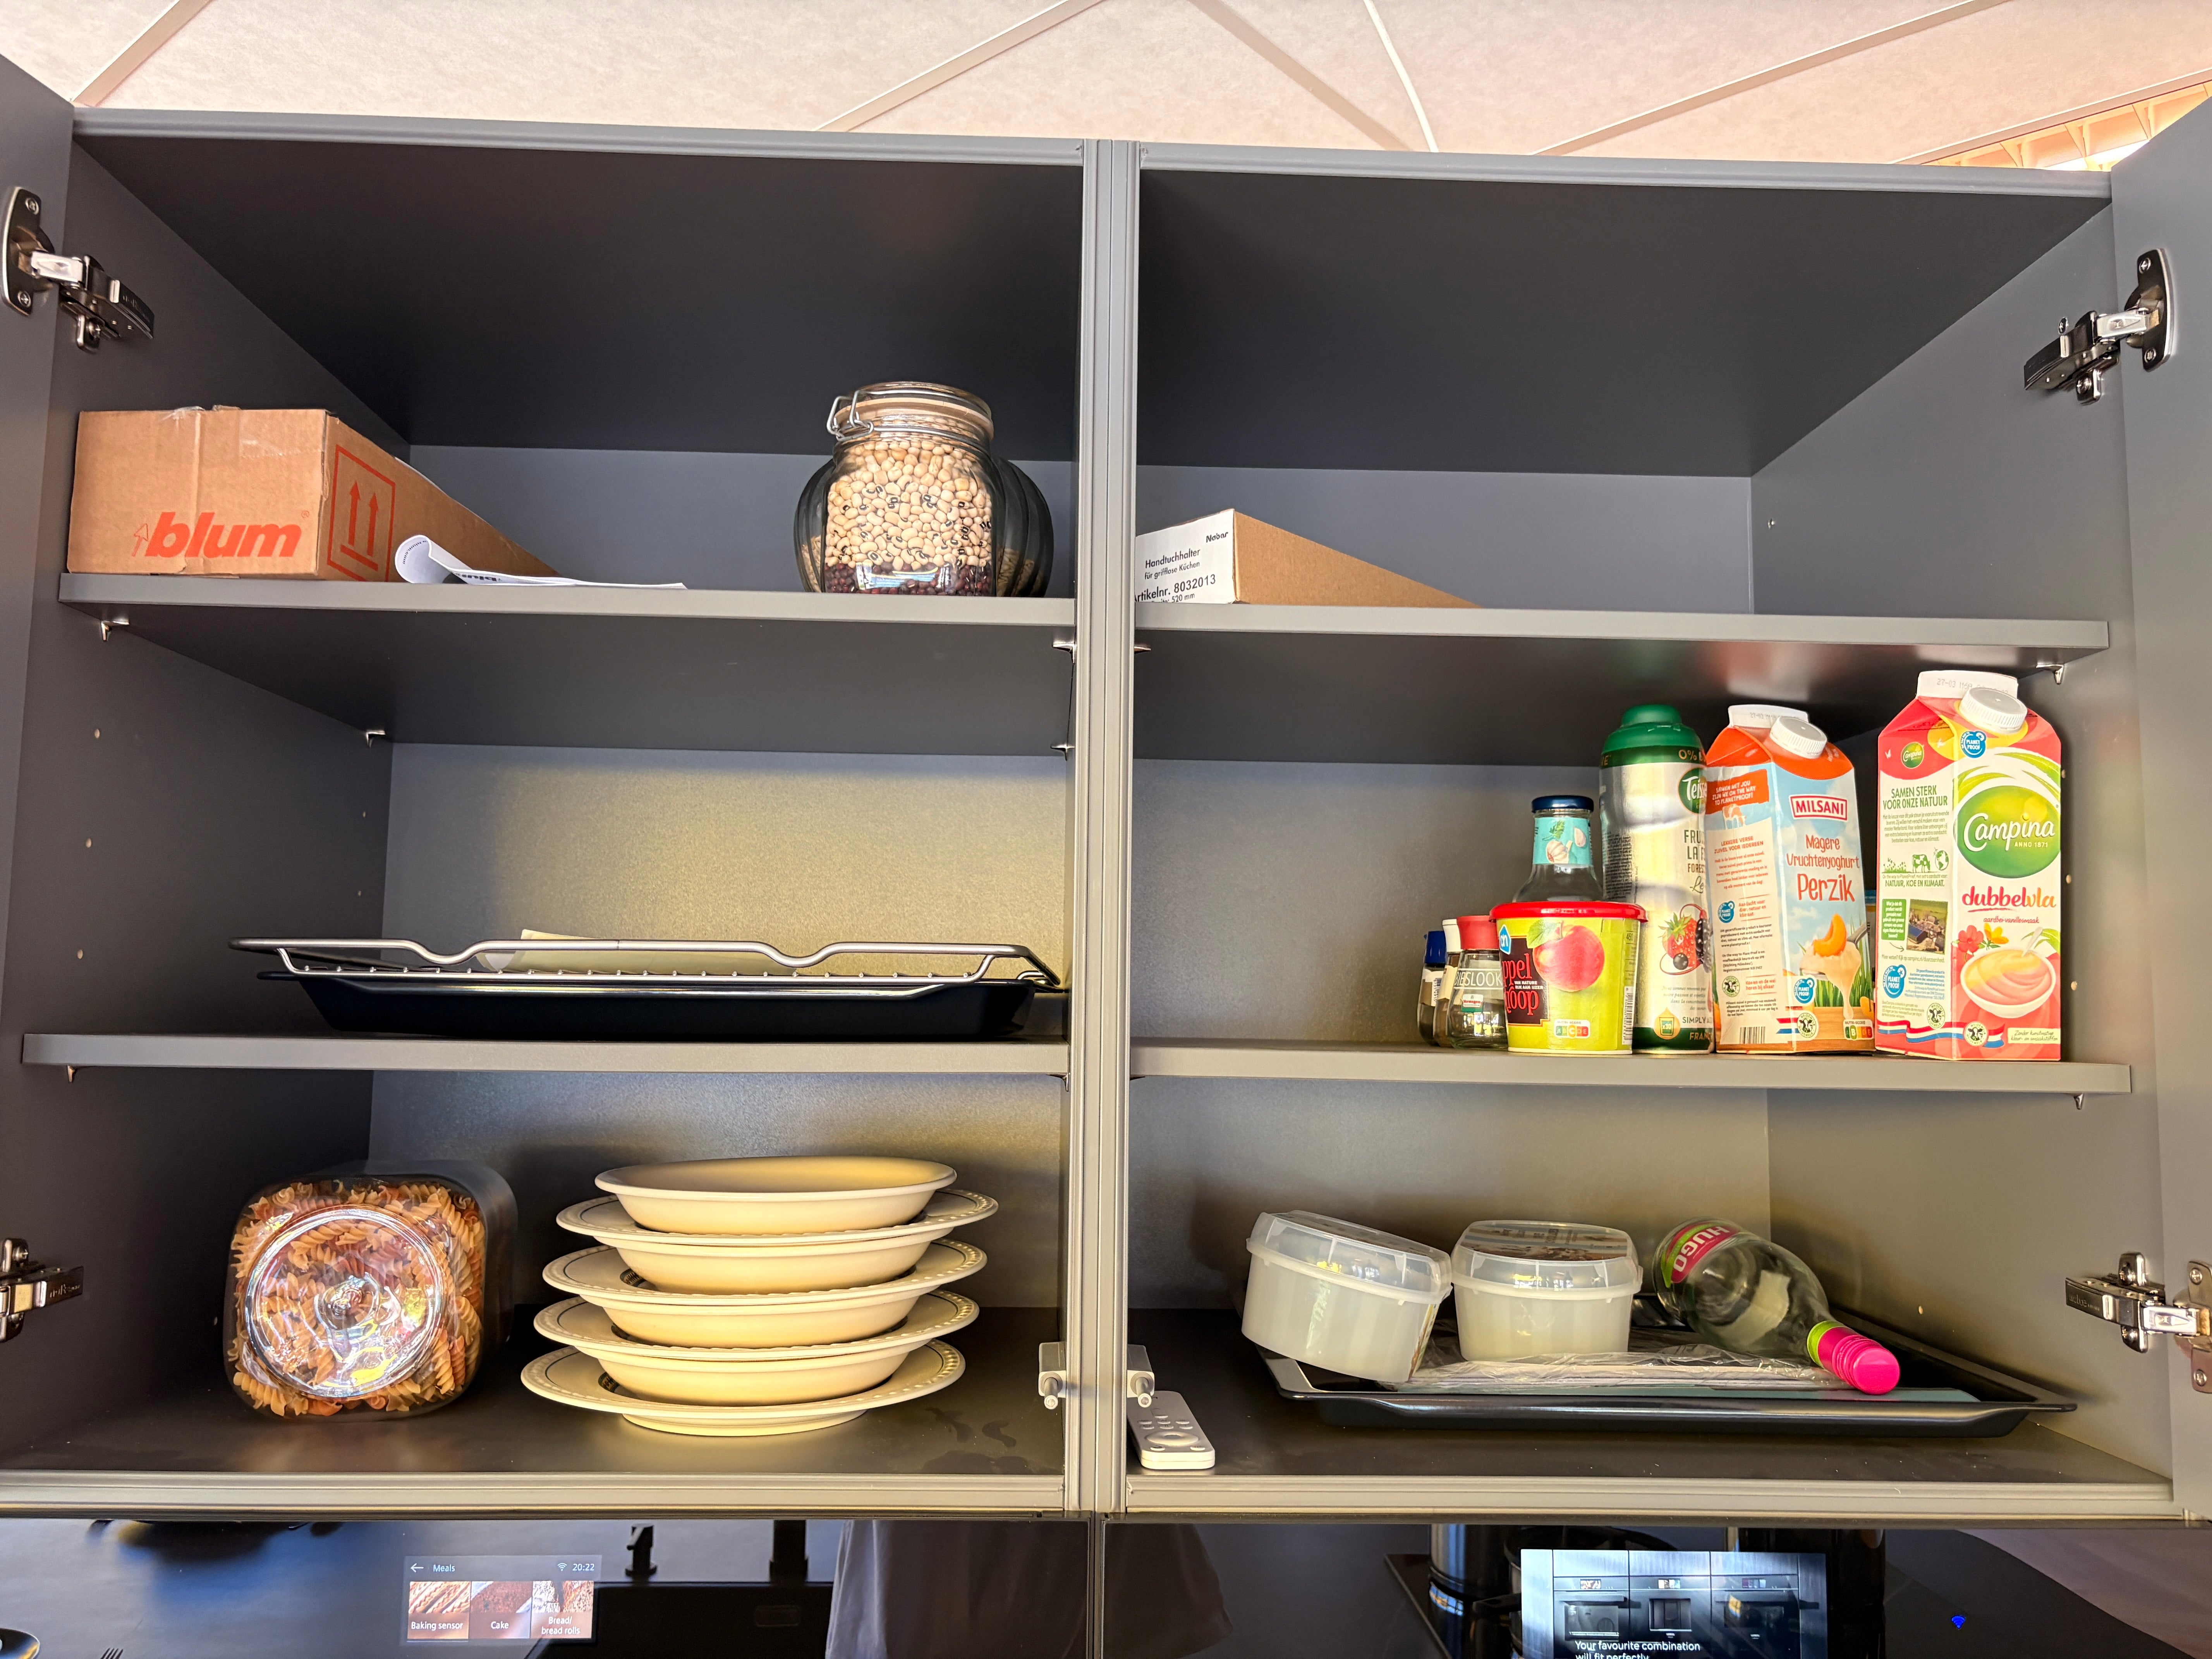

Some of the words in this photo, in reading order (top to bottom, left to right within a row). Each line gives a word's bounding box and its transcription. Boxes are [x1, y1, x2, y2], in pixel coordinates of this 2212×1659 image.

[145, 512, 302, 558] blum
[1146, 548, 1200, 568] Handtuchhalter
[1154, 567, 1178, 579] grifflose
[1179, 562, 1200, 571] Küchen
[1174, 574, 1216, 593] 8032013
[1172, 594, 1182, 603] 520
[1679, 750, 1697, 761] 0%
[1891, 787, 1915, 798] SAMEN
[1916, 785, 1937, 796] STERK
[1796, 800, 1843, 816] MILSANI
[1883, 799, 1901, 810] VOOR
[1902, 798, 1918, 808] ONZE
[1920, 796, 1948, 807] NATUUR
[1964, 813, 2055, 852] Campina
[1805, 835, 1840, 852] Magere
[1687, 846, 1698, 860] LA
[1786, 853, 1860, 871] Vruchtenyoghurt
[1797, 874, 1855, 902] Perzik
[1962, 886, 2056, 907] dubbelvla
[1502, 953, 1532, 987] ppel
[1455, 972, 1503, 986] BIESLOOK
[1673, 1226, 1730, 1272] HUGO
[433, 1565, 455, 1573] Meals
[572, 1563, 595, 1571] 20:22
[411, 1621, 436, 1630] Baking
[491, 1621, 509, 1630] Cake
[548, 1616, 572, 1625] Bread/
[542, 1626, 563, 1635] bread
[1575, 1641, 1595, 1651] Your
[1598, 1640, 1639, 1650] favourite
[1642, 1642, 1700, 1651] combination
